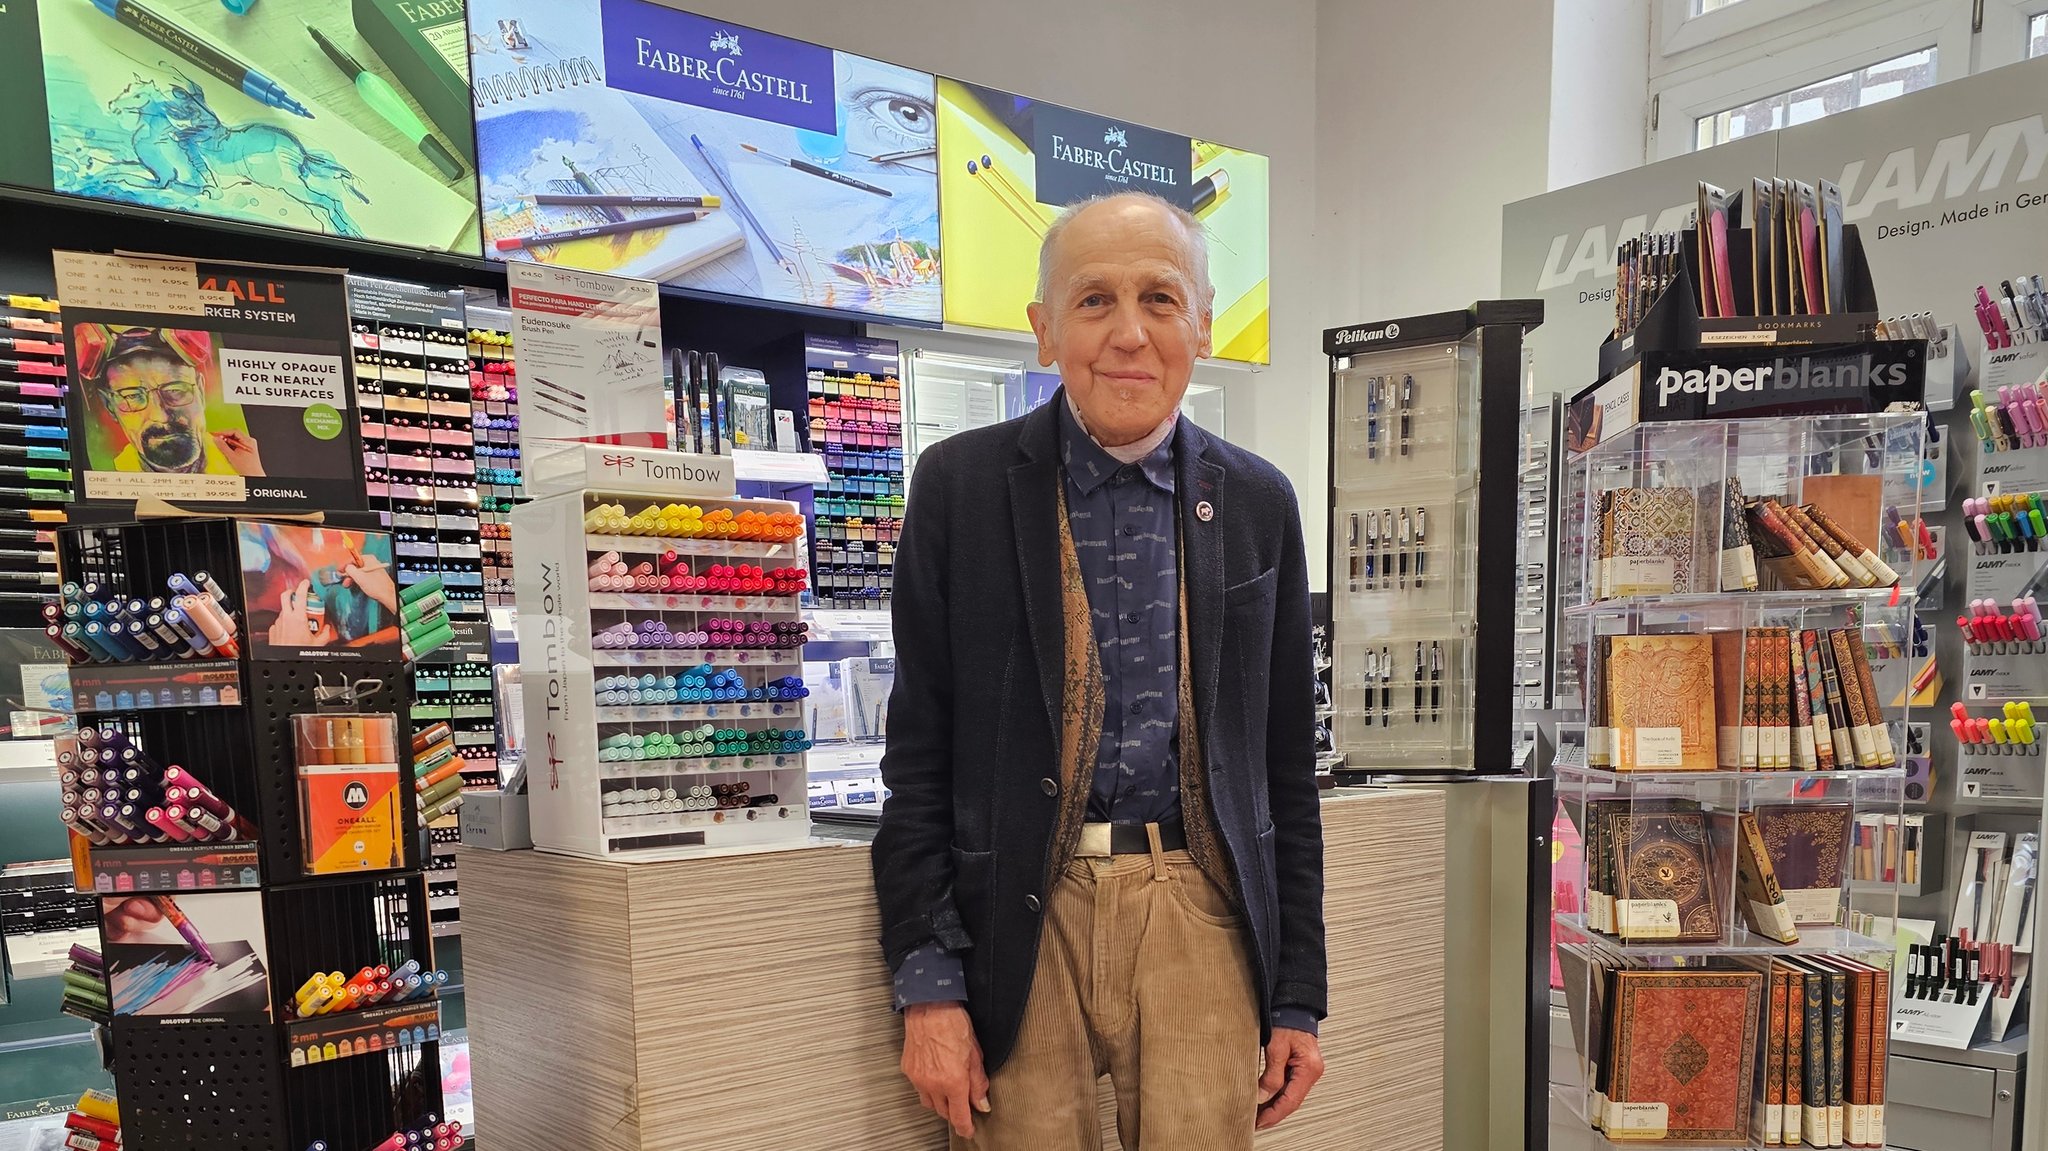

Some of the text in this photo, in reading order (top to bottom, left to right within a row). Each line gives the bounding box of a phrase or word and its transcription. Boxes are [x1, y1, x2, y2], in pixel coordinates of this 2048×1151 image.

[140, 14, 199, 53] FABER-CASTELL
[636, 37, 813, 104] FABER-CASTELL
[712, 86, 745, 101] since 1761
[1052, 135, 1177, 185] FABER-CASTELL
[1842, 113, 2048, 222] LAMY
[1105, 173, 1118, 182] since
[1878, 220, 1935, 240] Design.
[1940, 205, 1989, 227] Made
[1995, 201, 2009, 214] in
[574, 277, 615, 292] Tombow
[518, 293, 551, 304] PERFECTO
[551, 297, 568, 306] PARA
[245, 310, 296, 323] SYSTEM
[521, 316, 571, 330] Fudenosuke
[521, 326, 541, 334] Brush
[1757, 321, 1822, 330] BOOKMARKS
[1335, 329, 1384, 345] Pelikan
[1989, 352, 2020, 365] LAMY
[227, 358, 337, 374] HIGHLY OPAQUE
[241, 373, 325, 386] FOR NEARLY
[1655, 354, 1907, 407] paperblanks
[235, 385, 335, 400] ALL SURFACES
[1604, 391, 1630, 413] PENCIL CASES
[642, 459, 721, 483] Tombow
[1983, 465, 2012, 475] LAMY
[253, 488, 308, 499] ORIGINAL
[1629, 558, 1667, 567] paperblanks
[1975, 559, 2007, 570] LAMY
[541, 562, 560, 721] Tombow
[203, 672, 238, 681] MOLOTO
[1970, 668, 1998, 677] LAMY
[74, 678, 101, 687] 4 mm
[1964, 767, 1991, 776] LAMY
[337, 816, 377, 825] ONE4ALL
[94, 859, 122, 868] 4 mm
[222, 855, 258, 864] MOLOTO
[1896, 1008, 1925, 1016] LAMY
[291, 1032, 319, 1043] 2 mm
[6, 1104, 78, 1120] FABER-CASTEL
